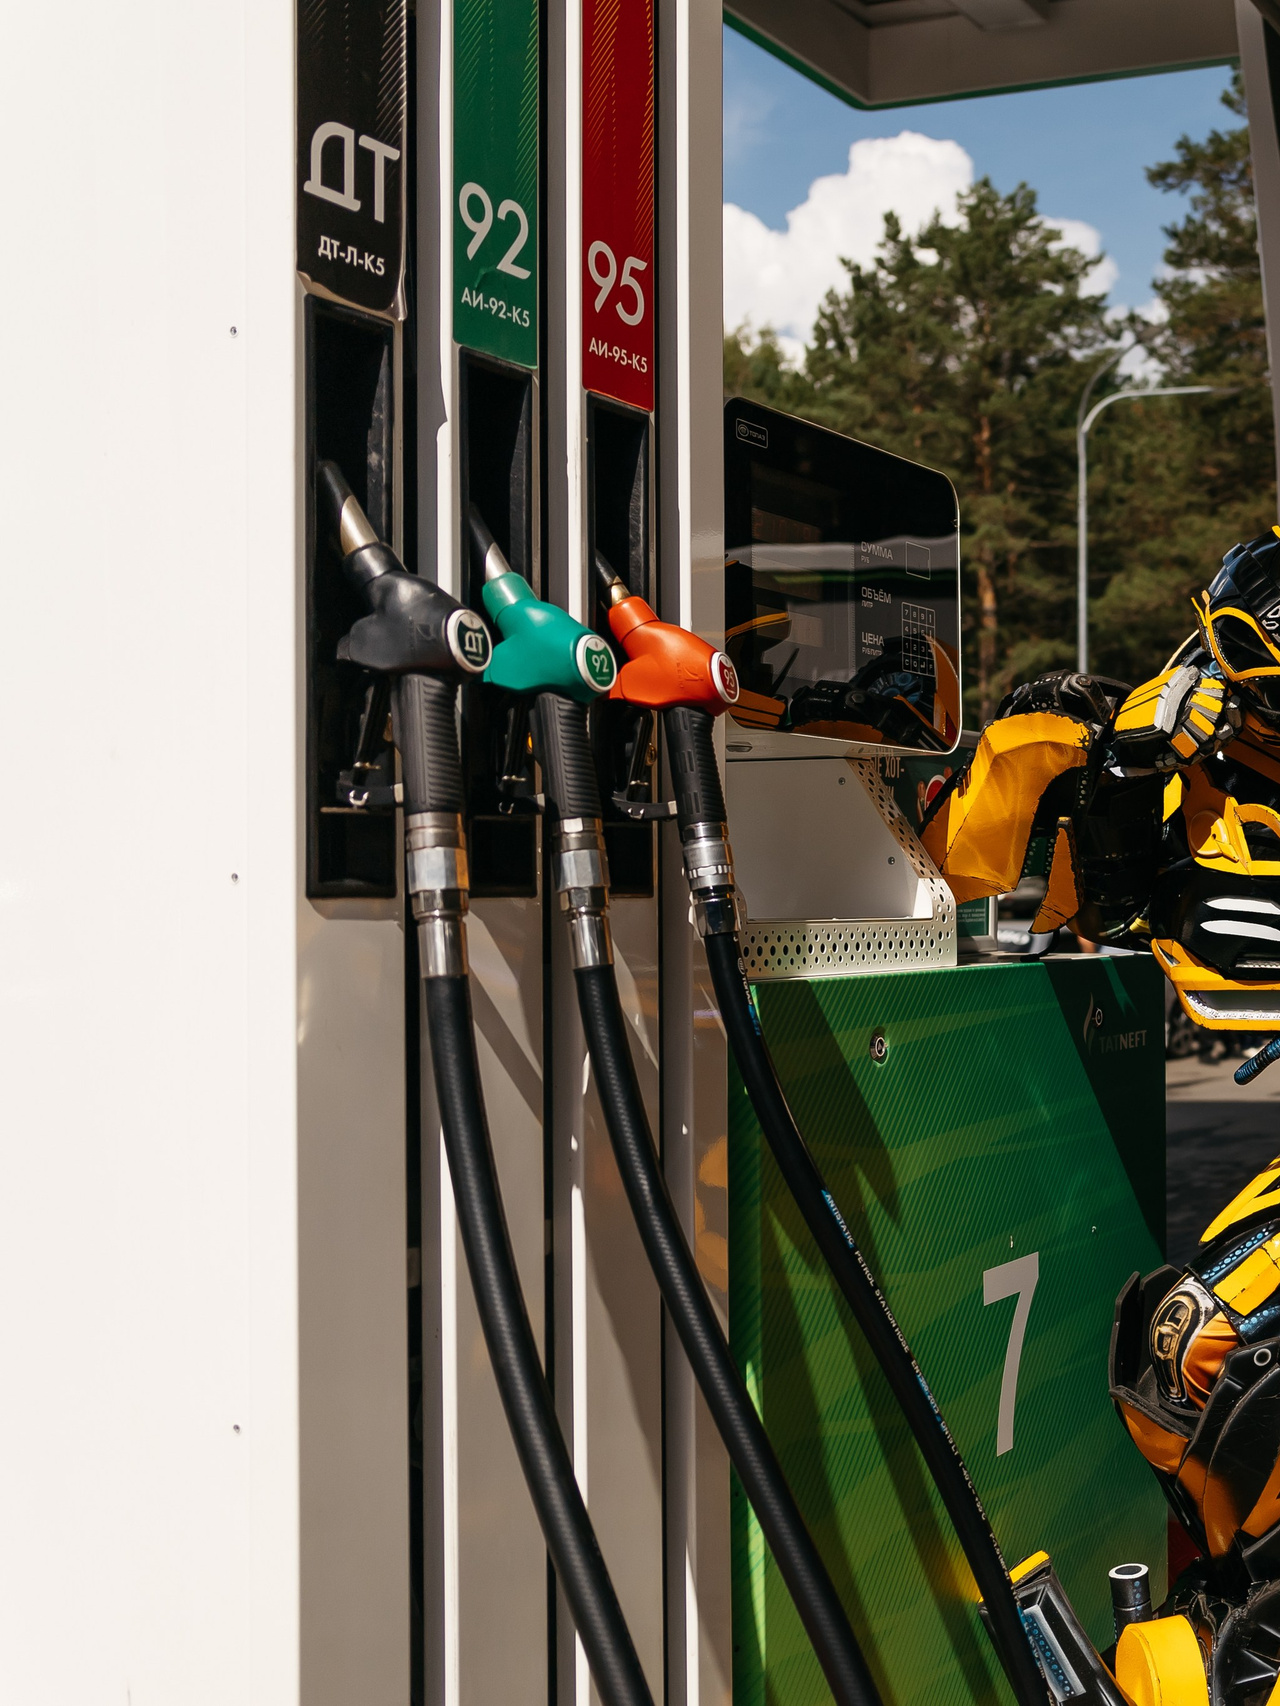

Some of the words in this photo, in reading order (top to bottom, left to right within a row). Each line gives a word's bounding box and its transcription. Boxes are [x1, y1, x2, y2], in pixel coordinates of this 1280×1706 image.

[303, 121, 400, 224] ДТ
[458, 181, 531, 280] 92
[318, 234, 385, 277] ДТ-Л-К5
[587, 240, 648, 326] 95
[461, 286, 530, 328] АИ-92-К5
[588, 336, 648, 374] АИ-95-К5
[860, 541, 894, 560] СУММА
[861, 586, 892, 604] ОБЪЁМ
[464, 631, 484, 654] ДТ
[861, 631, 885, 647] ЦЕНА
[591, 654, 610, 673] 92
[723, 668, 735, 688] 95
[1099, 1029, 1147, 1054] TATNEFT
[825, 1194, 855, 1246] ANTISTATIC
[854, 1250, 875, 1287] PETROL
[875, 1289, 897, 1328] STATION
[894, 1327, 910, 1353] HOSE
[983, 1251, 1039, 1457] 7
